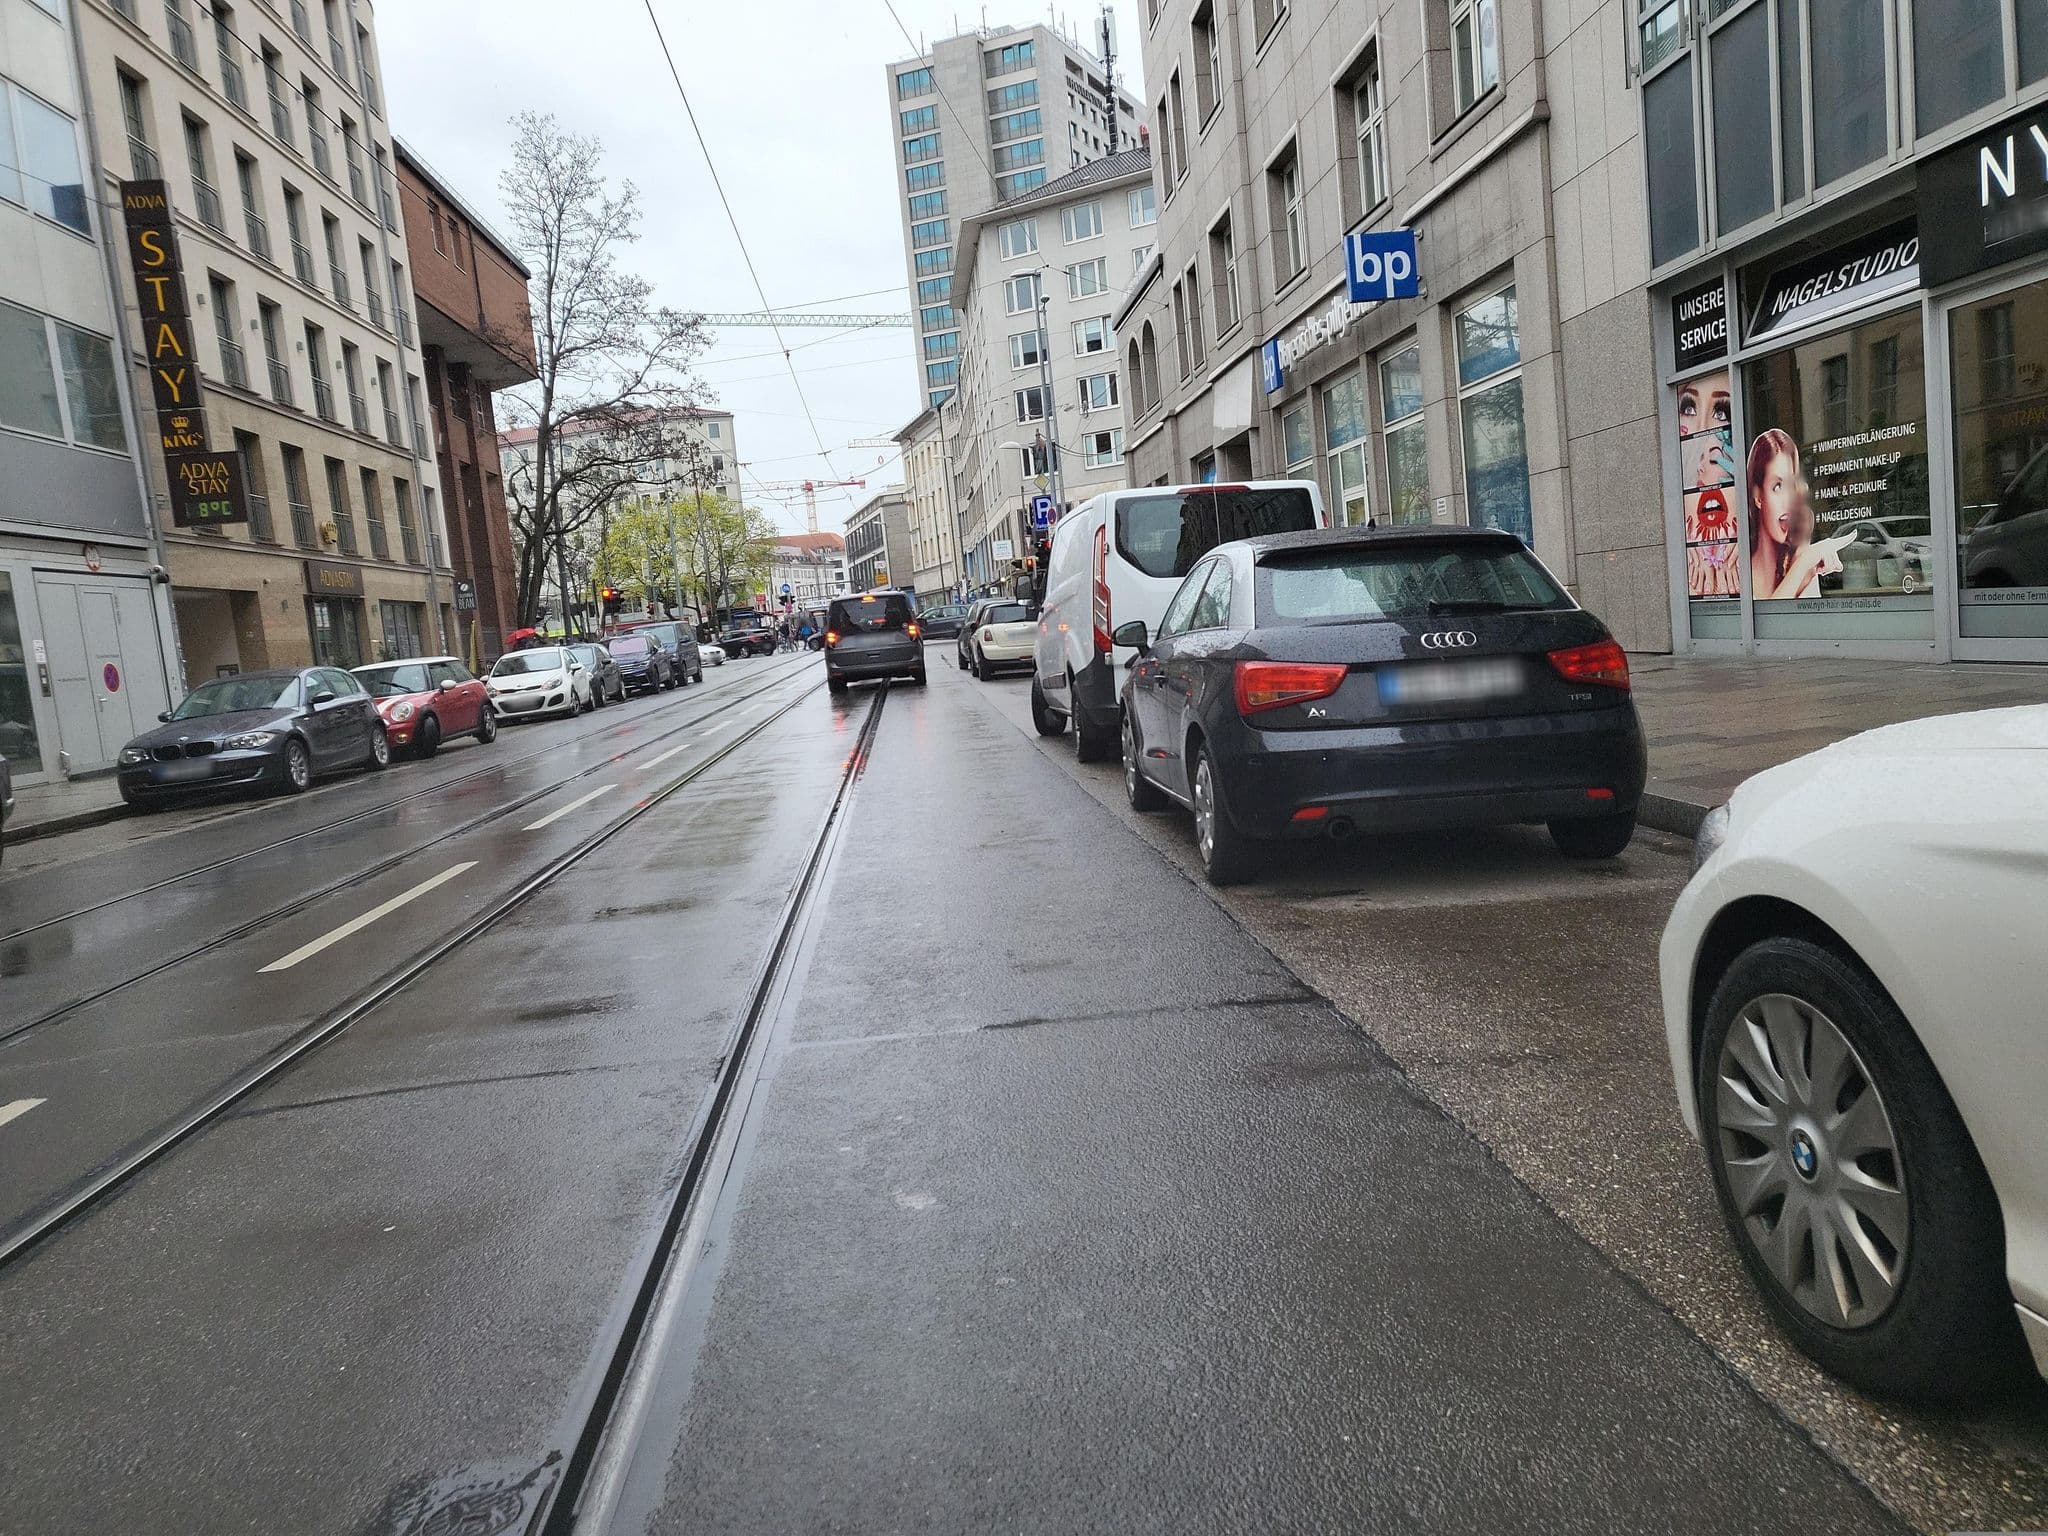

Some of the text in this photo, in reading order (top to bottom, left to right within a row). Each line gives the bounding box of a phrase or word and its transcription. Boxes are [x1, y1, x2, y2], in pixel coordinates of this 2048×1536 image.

[124, 195, 166, 210] ADVA
[1353, 233, 1412, 298] bp
[1771, 237, 1919, 316] NAGELSTUDIO
[1680, 287, 1725, 321] UNSERE
[140, 230, 186, 403] STAY
[1681, 318, 1727, 351] SERVICE
[179, 461, 230, 480] ADVA
[1819, 458, 1864, 476] PERMANENT
[1865, 451, 1901, 468] MAKE-UP
[189, 478, 230, 496] STAY
[1820, 486, 1841, 499] MANI-
[1842, 485, 1848, 496] &
[1849, 479, 1887, 495] PEDIKURE
[1821, 506, 1872, 523] NAGELDESIGN
[1974, 592, 1986, 601] mit
[1988, 591, 2006, 601] oder
[2006, 591, 2026, 601] ohne
[1307, 707, 1326, 719] A1
